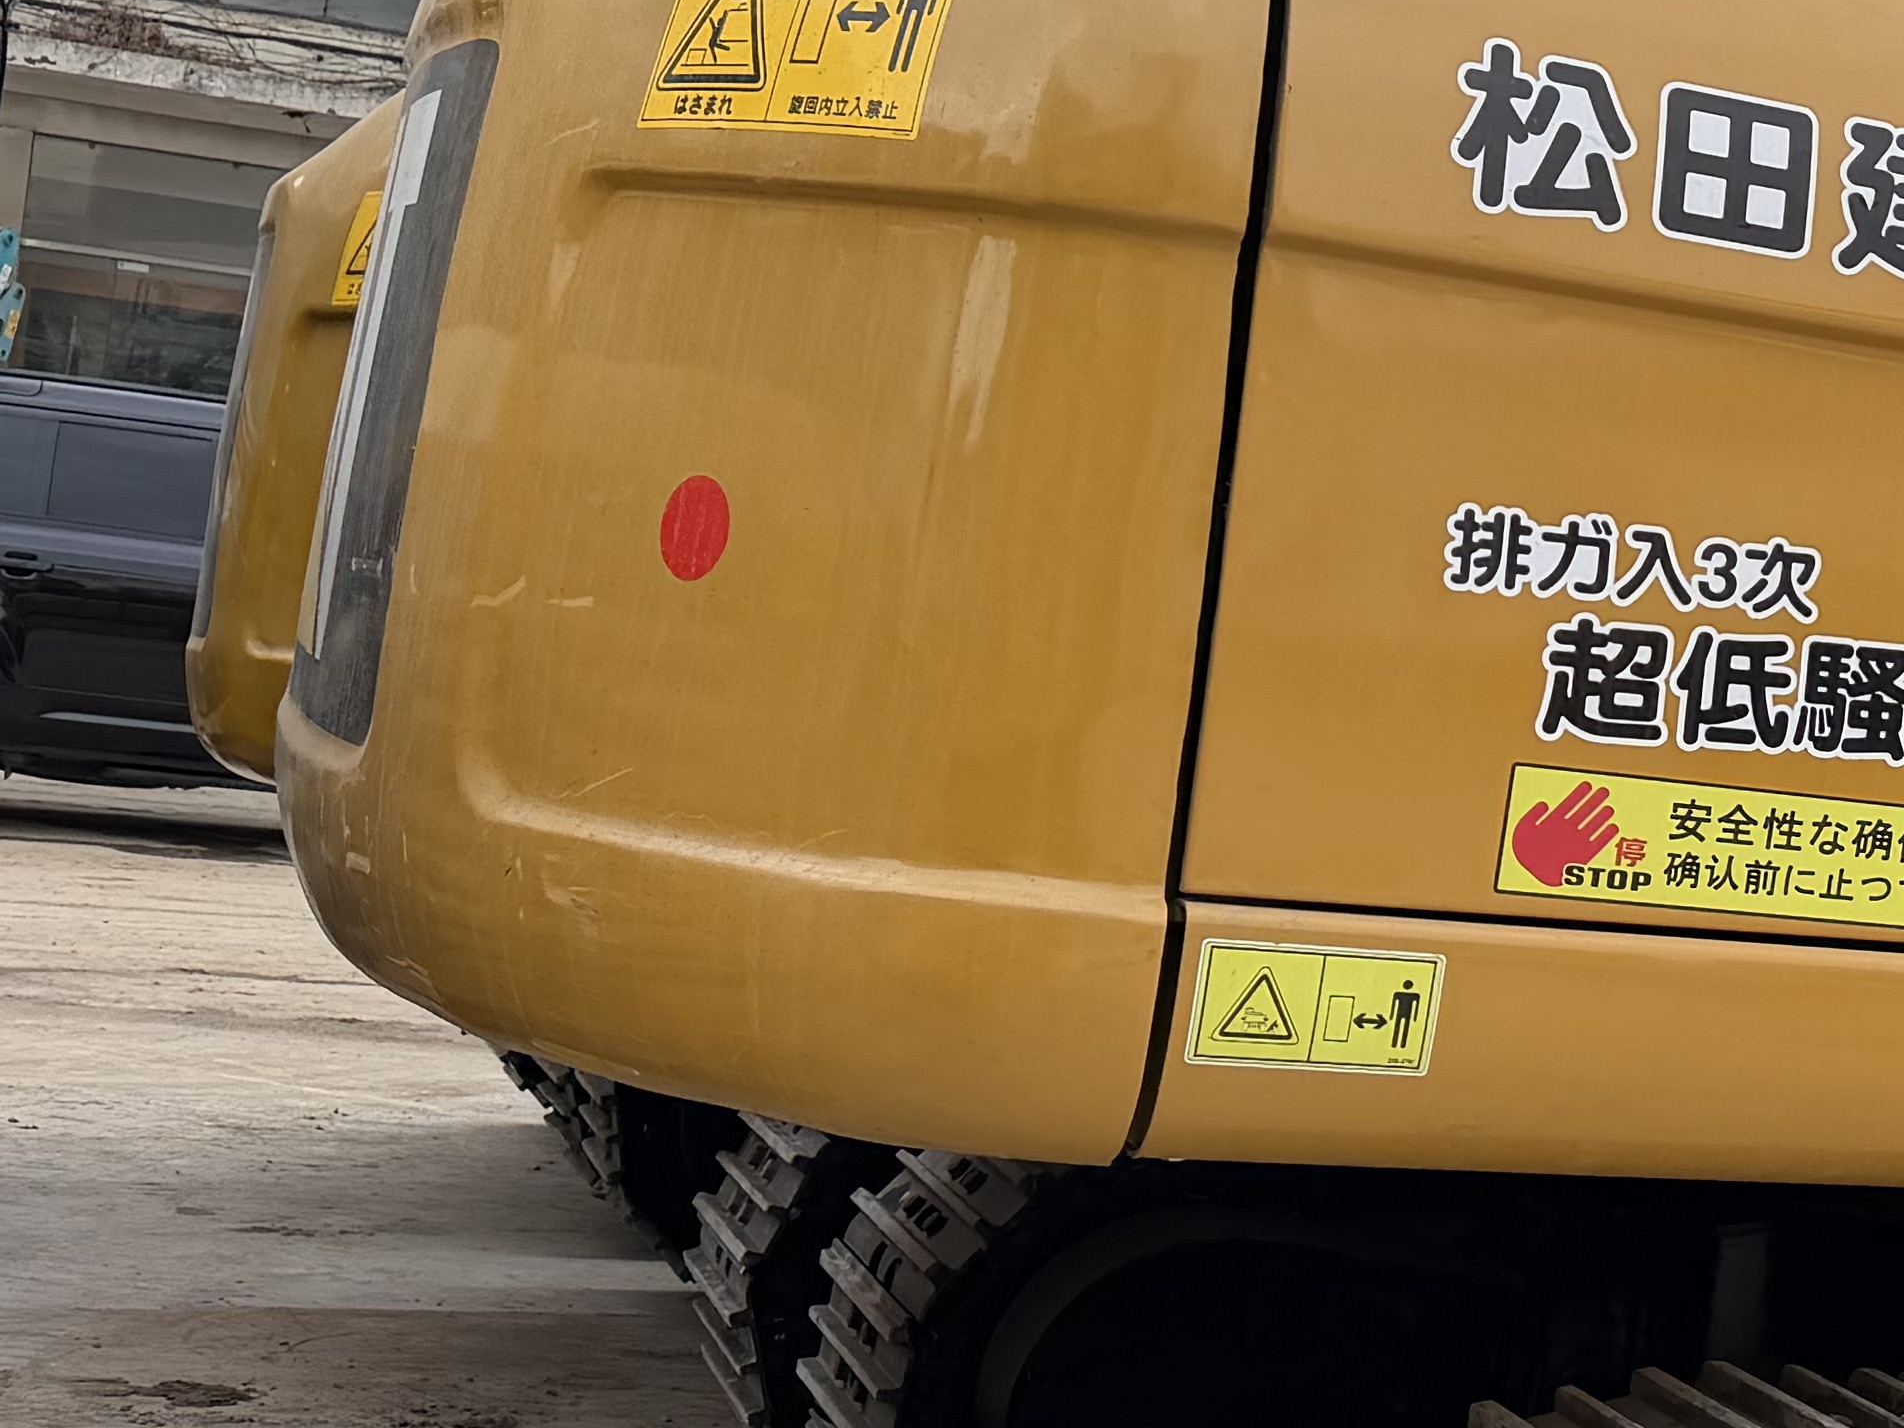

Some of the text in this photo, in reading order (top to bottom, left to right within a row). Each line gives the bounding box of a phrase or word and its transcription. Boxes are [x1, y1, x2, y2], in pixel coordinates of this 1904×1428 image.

[673, 94, 733, 116] はさまれ
[1614, 836, 1648, 867] 停
[1562, 865, 1652, 893] STOP
